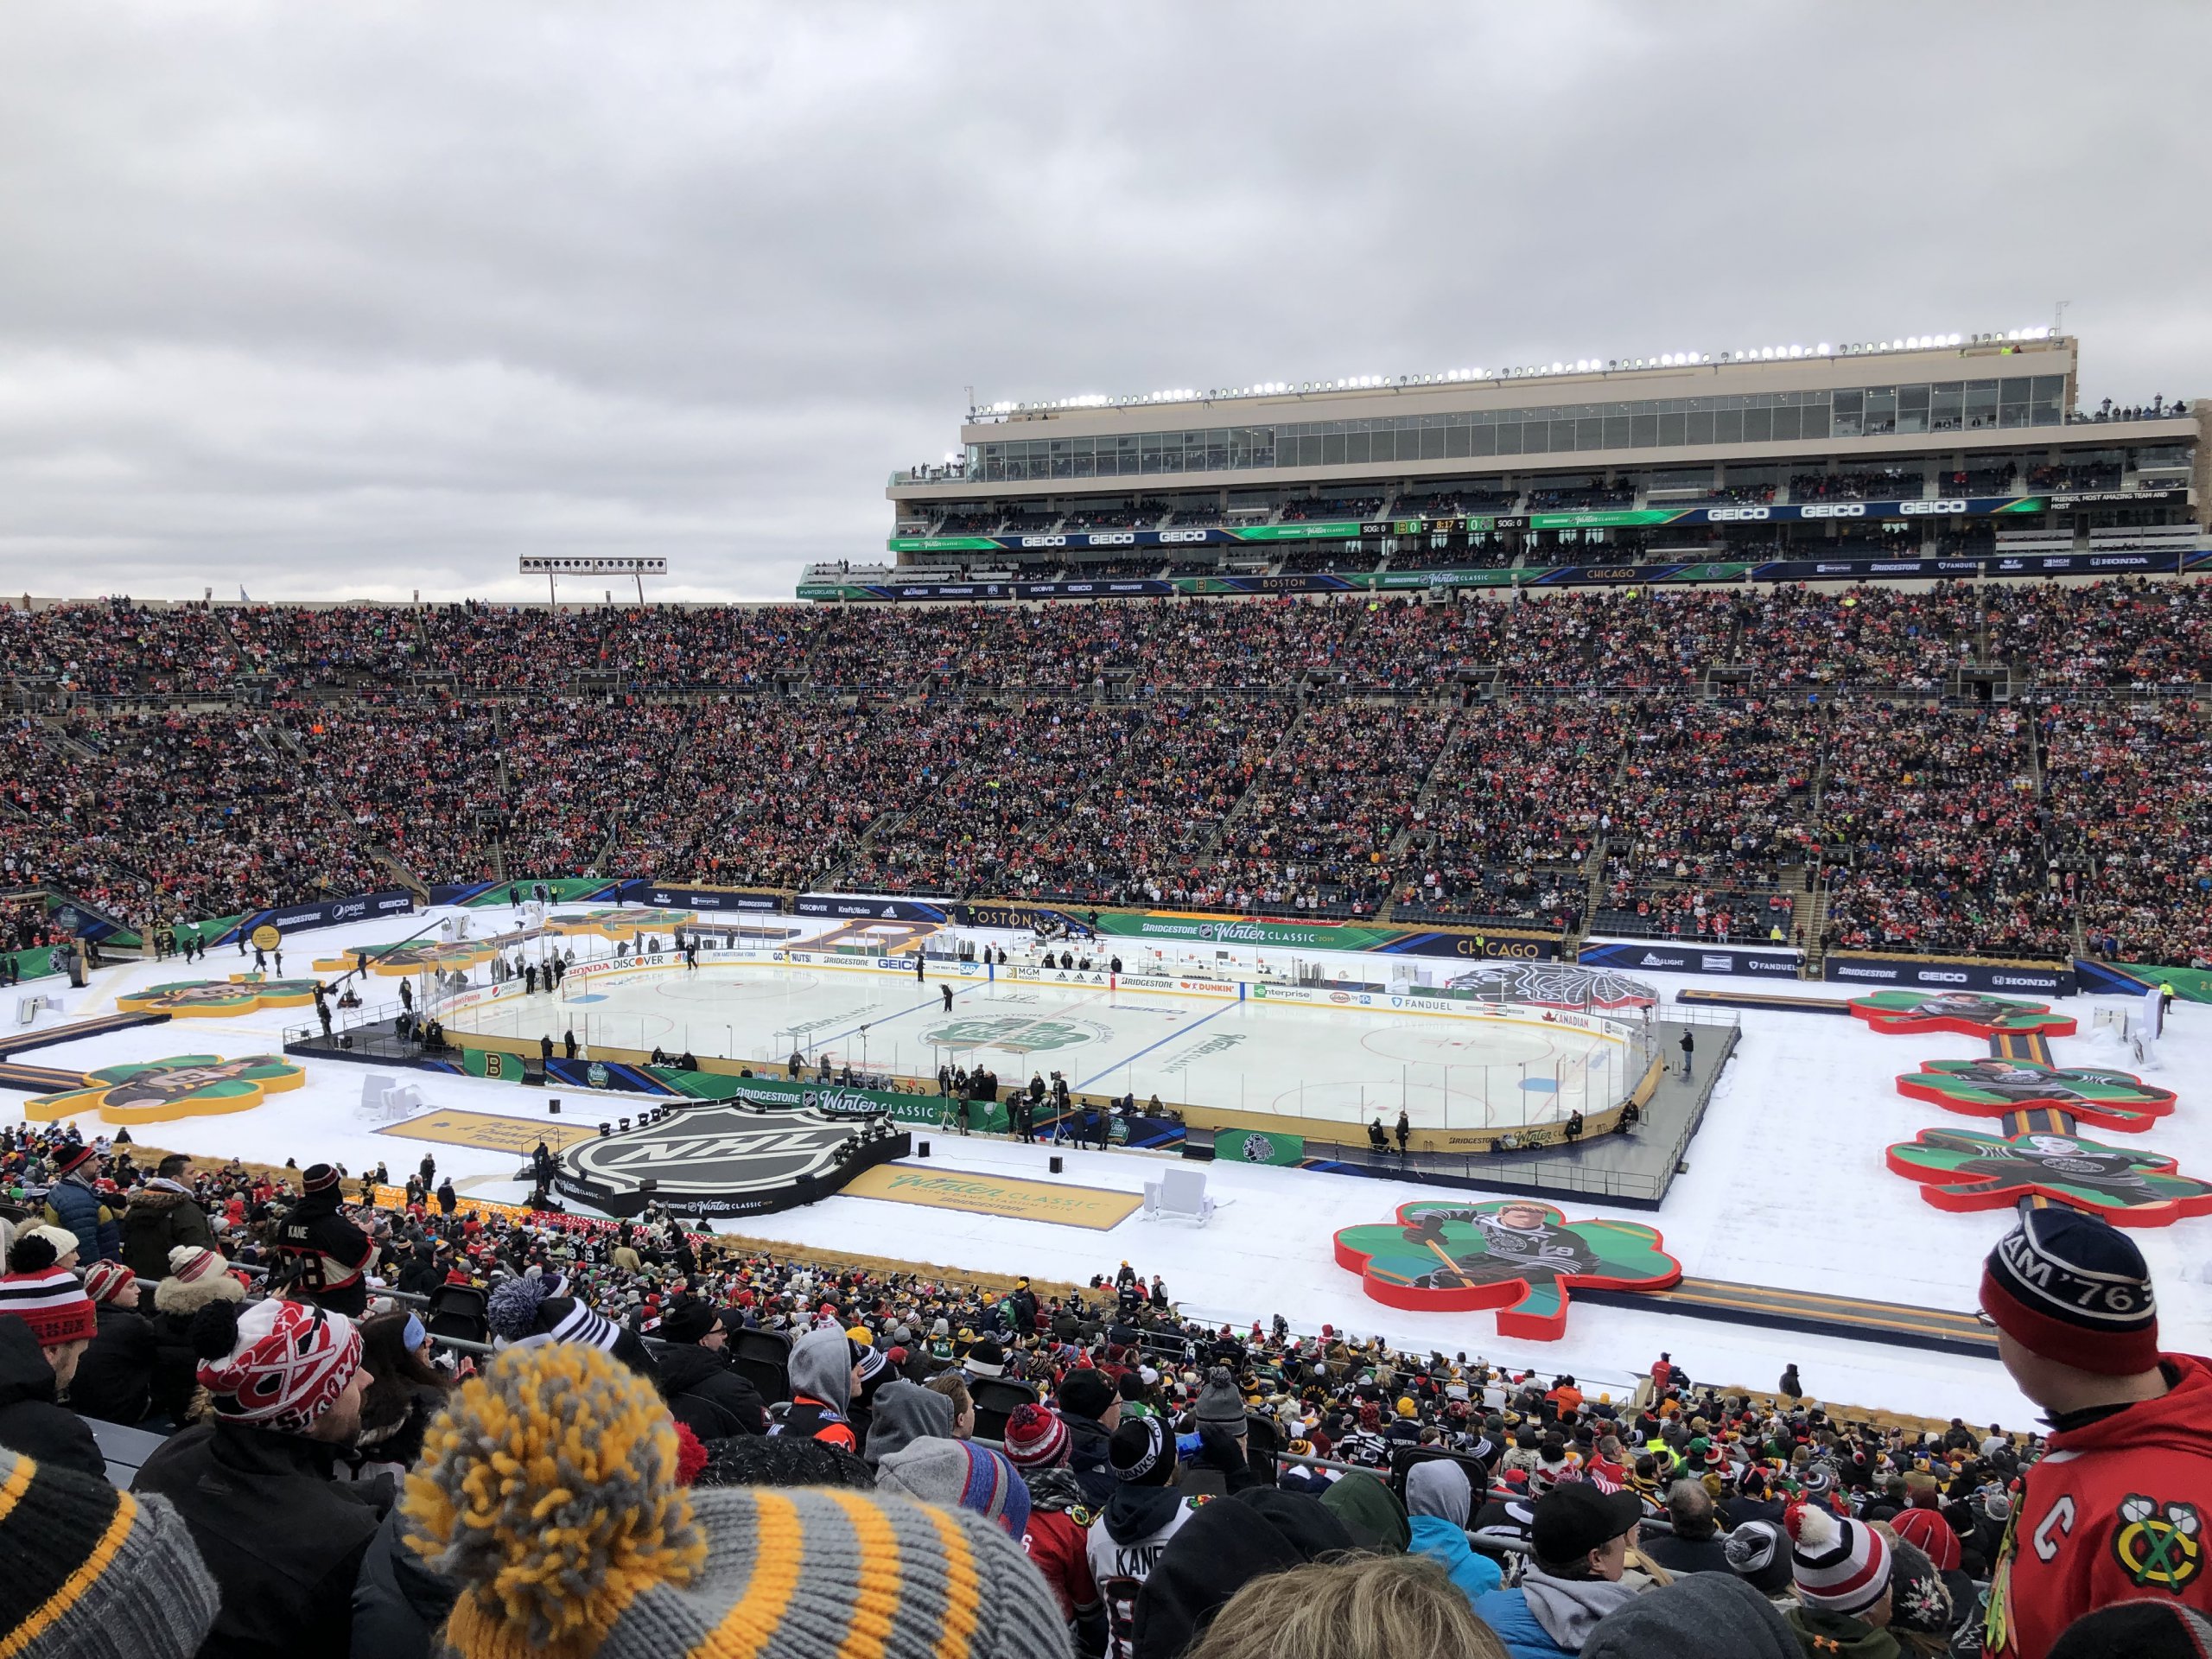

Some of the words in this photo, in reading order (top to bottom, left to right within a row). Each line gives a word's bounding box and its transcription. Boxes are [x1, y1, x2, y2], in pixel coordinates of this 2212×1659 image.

[1801, 505, 1866, 518] GEICO
[1899, 500, 1966, 514] GEICO
[1707, 508, 1770, 522] GEICO
[1409, 522, 1417, 532] 0
[1436, 520, 1454, 530] 8:17
[1471, 520, 1478, 531] 0
[1021, 536, 1066, 548] GEICO
[1089, 533, 1135, 545] GEICO
[1159, 531, 1207, 543] GEICO
[1870, 563, 1921, 571] BRIDGESTONE
[1384, 575, 1420, 585] BRIDGESTONE
[1428, 572, 1460, 588] Winter
[1586, 569, 1636, 579] CHICAGO
[1067, 584, 1093, 593] GEICO
[1262, 579, 1306, 588] BOSTON
[344, 901, 365, 914] pepsi
[378, 899, 409, 910] GEICO
[737, 899, 773, 908] BRIDGESTONE
[799, 903, 828, 912] DISCOVER
[276, 912, 321, 926] BRIDGESTONE
[977, 911, 1033, 926] OSTON
[1141, 923, 1198, 934] BRIDGESTONE
[1214, 920, 1266, 943] Winter
[1268, 931, 1315, 943] CLASSIC
[613, 955, 664, 970] DISCOVER
[772, 952, 783, 962] GO
[791, 952, 811, 963] NUTS!
[823, 955, 869, 967] BRIDGESTONE
[569, 962, 610, 976] HONDA
[960, 963, 976, 974] SAP
[1019, 967, 1040, 976] MGM
[1759, 962, 1797, 972] FANDUEL
[1838, 966, 1898, 978] BRIDGESTONE
[1121, 976, 1174, 989] BRIDGESTONE
[1917, 970, 1968, 983] GEICO
[2005, 977, 2057, 988] HONDA
[501, 982, 518, 995] pepsi
[1198, 983, 1235, 993] DUNKIN'
[1405, 999, 1452, 1011] FANDUEL
[1554, 1013, 1589, 1028] CANADIAN
[484, 1052, 503, 1078] B
[736, 1086, 800, 1104] BRIDGESTONE
[819, 1088, 878, 1112] Winter
[880, 1103, 934, 1119] CLASSIC
[1514, 1127, 1553, 1149] Winter
[607, 1131, 823, 1165] NHL
[580, 1188, 599, 1199] CLASSIC
[887, 1173, 1006, 1198] Winter
[1007, 1192, 1102, 1210] CLASSIC
[696, 1198, 731, 1216] Winter
[731, 1201, 762, 1210] CLASSIC
[938, 1196, 1028, 1213] BRIDGESTONE
[288, 1224, 308, 1239] KANE
[584, 1249, 594, 1262] 19
[2056, 1274, 2134, 1313] '76
[1184, 1344, 1196, 1359] 19
[2033, 1494, 2075, 1565] C
